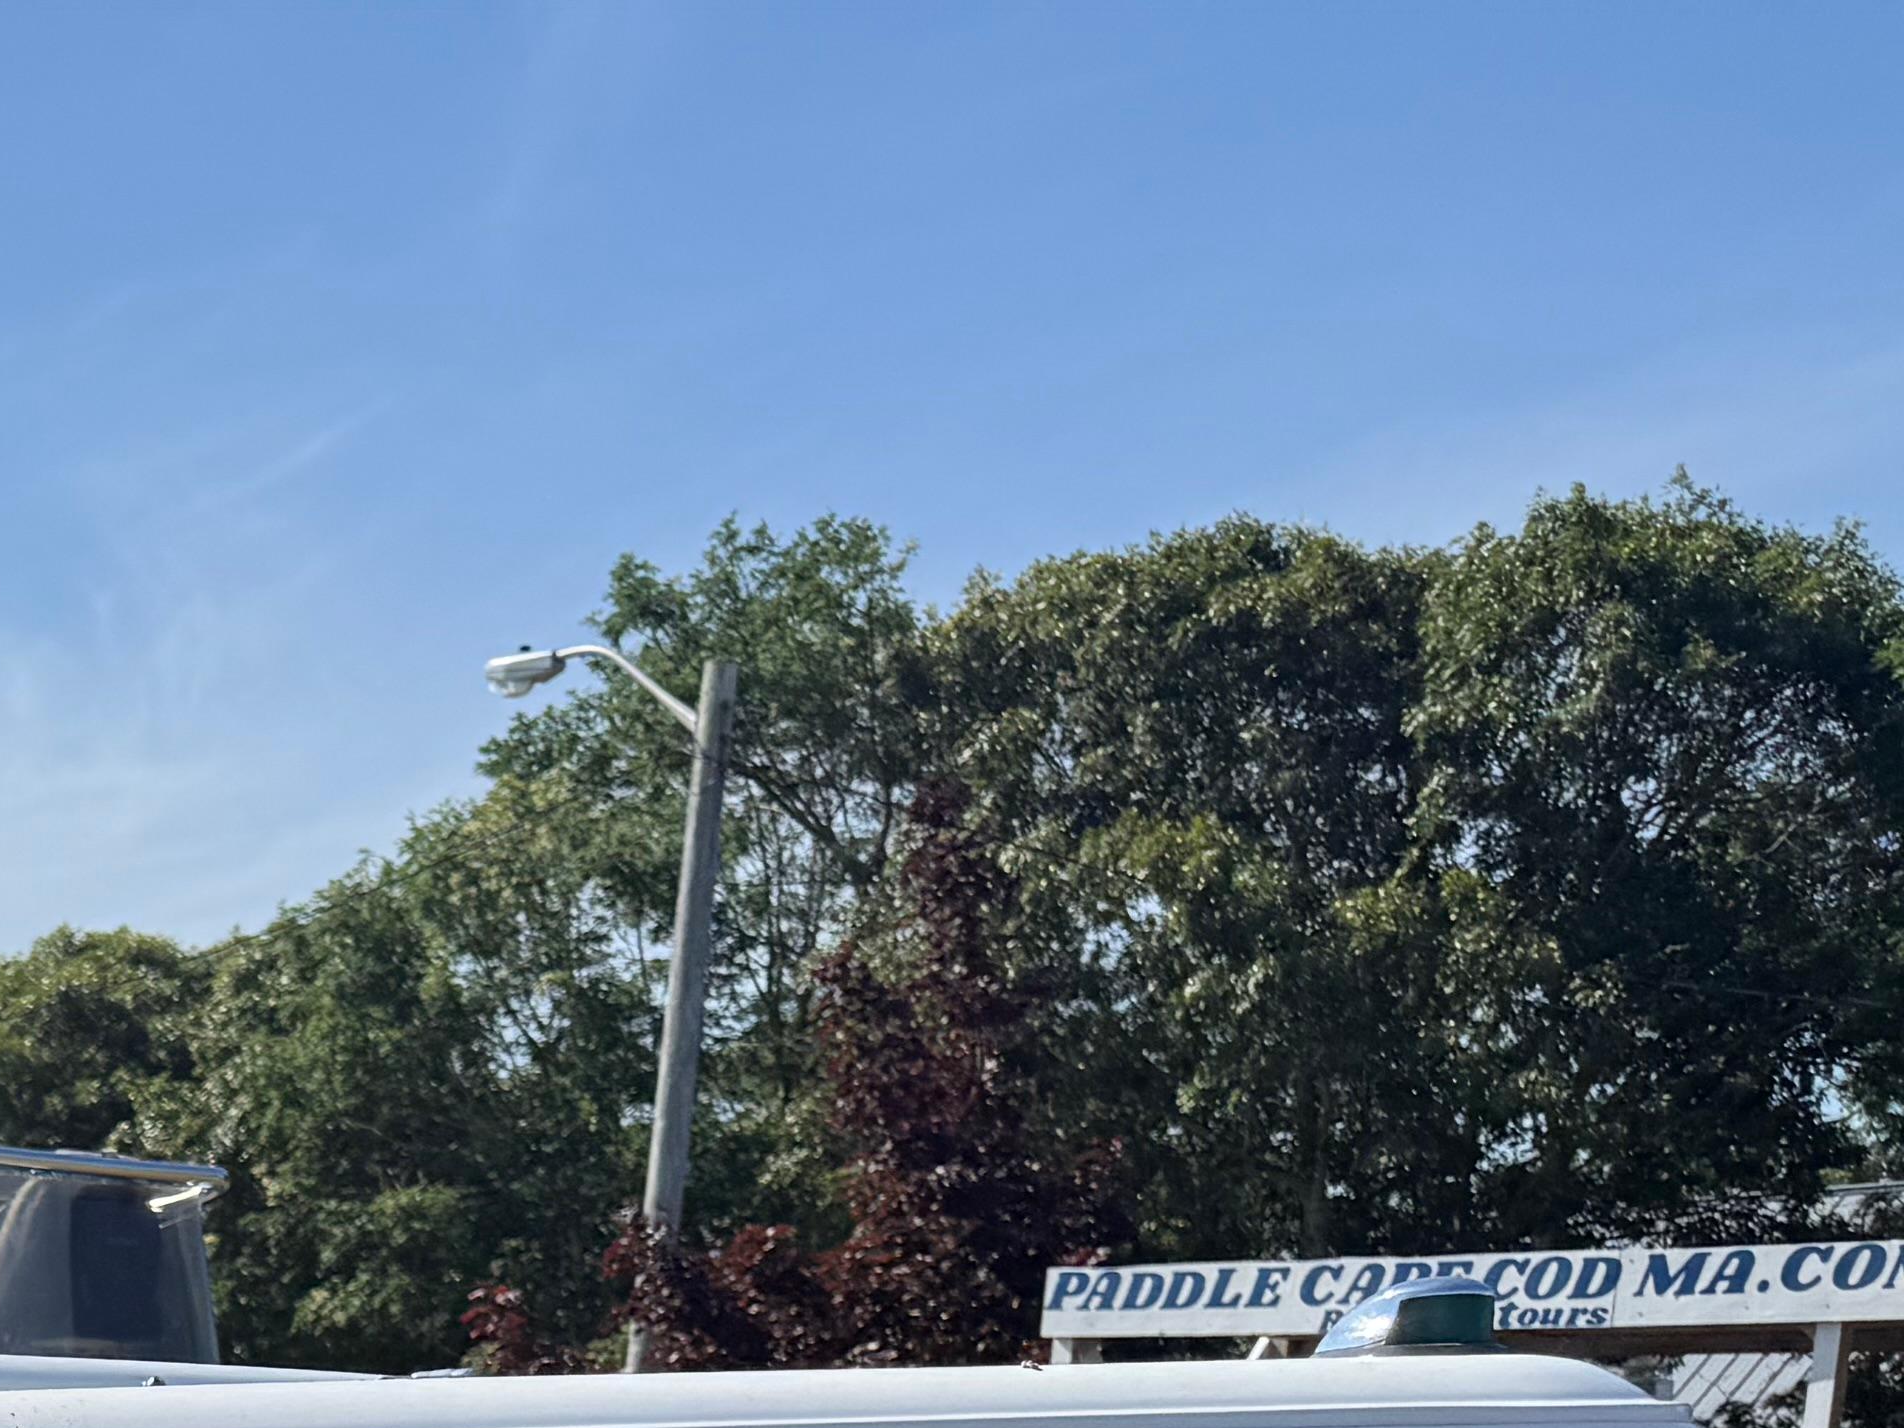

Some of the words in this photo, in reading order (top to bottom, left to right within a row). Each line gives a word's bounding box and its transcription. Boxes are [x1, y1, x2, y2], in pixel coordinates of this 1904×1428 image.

[1045, 1267, 1291, 1310] PADDLE
[1482, 1256, 1622, 1301] COD
[1633, 1244, 1904, 1299] MA.CO
[1498, 1302, 1609, 1328] tours
